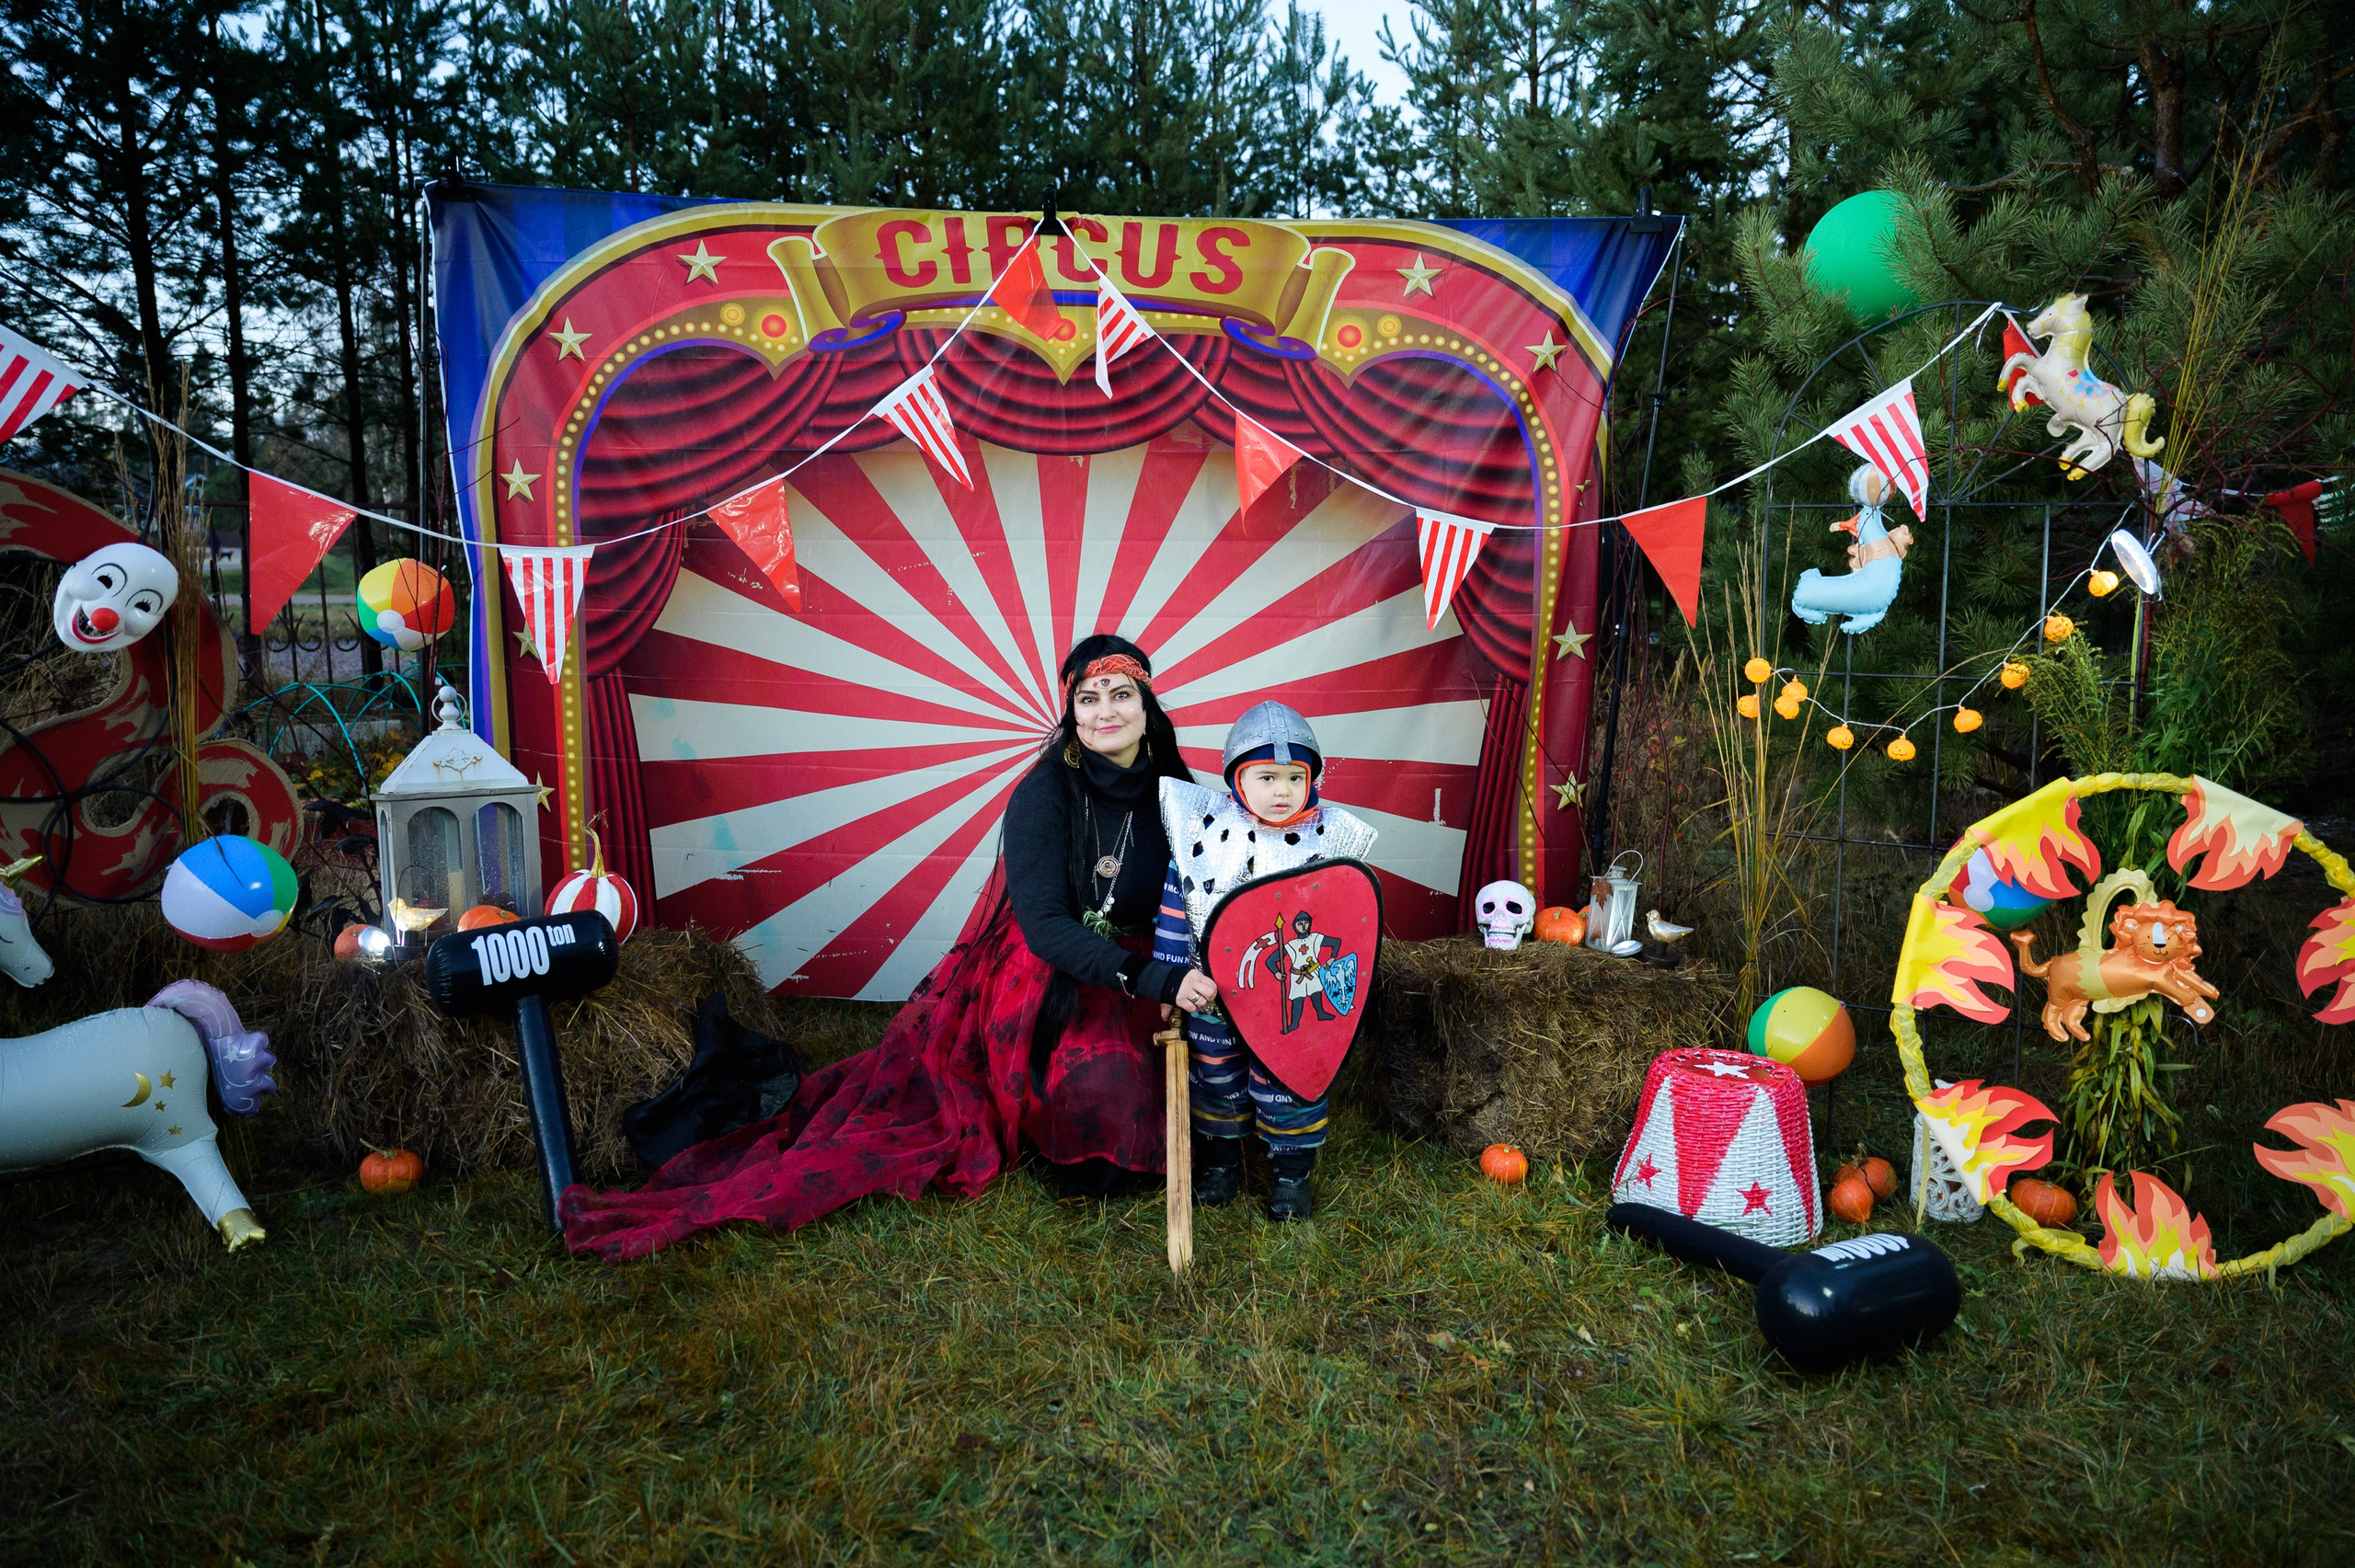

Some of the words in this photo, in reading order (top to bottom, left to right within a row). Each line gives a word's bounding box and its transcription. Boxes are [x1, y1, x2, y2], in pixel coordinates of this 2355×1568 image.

[471, 926, 550, 987] 1000
[546, 923, 576, 947] ton
[1166, 954, 1184, 964] FUN
